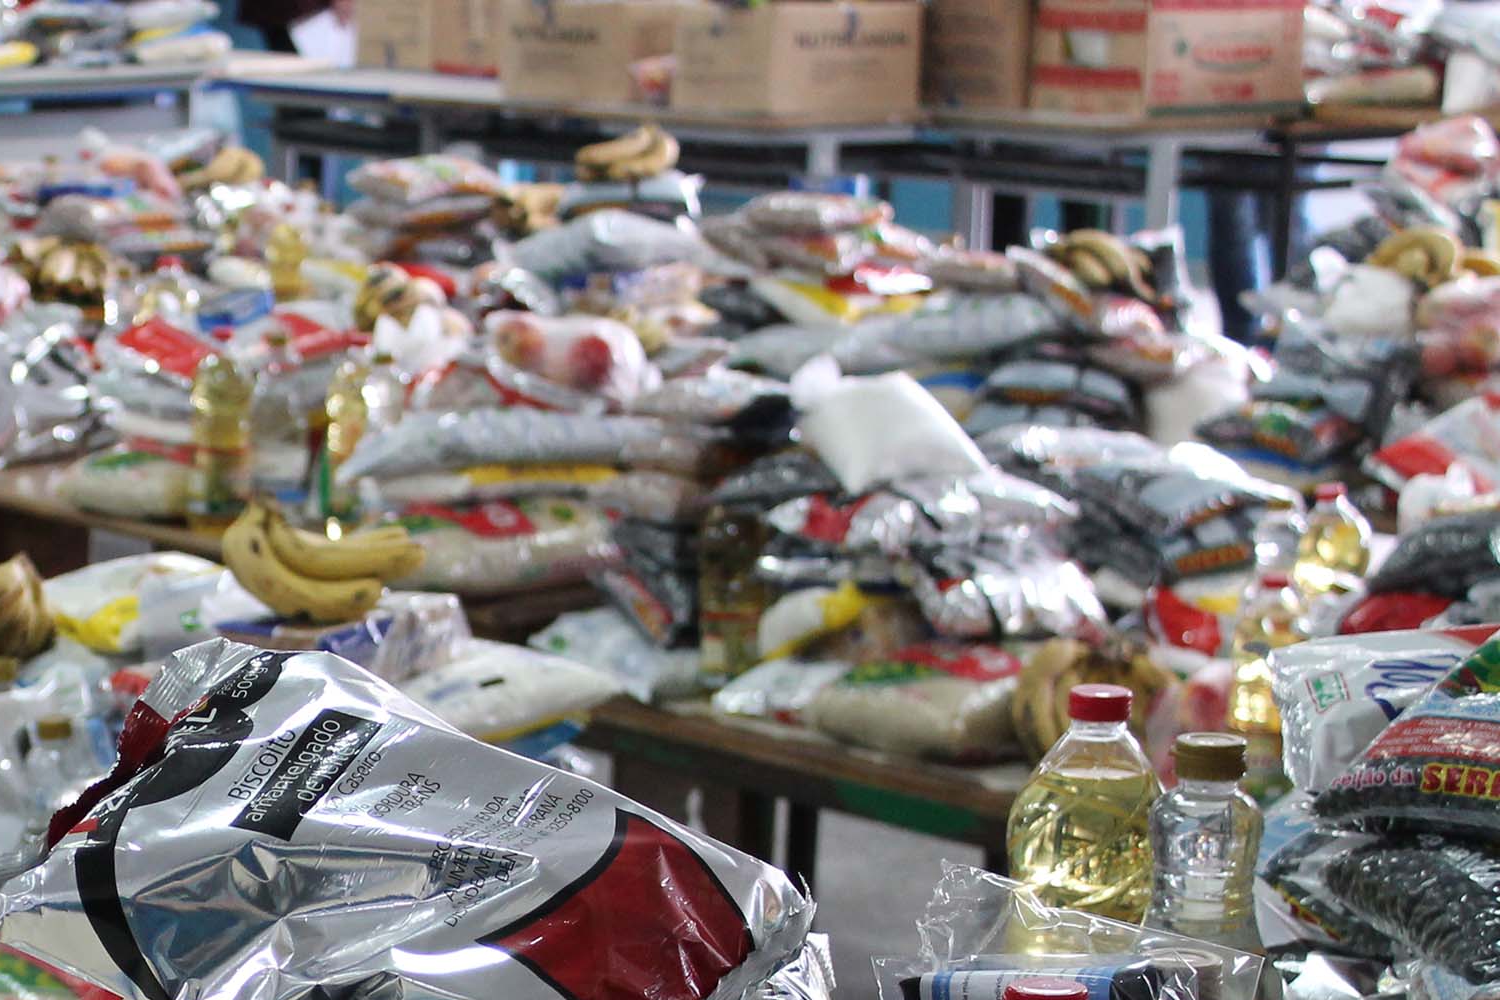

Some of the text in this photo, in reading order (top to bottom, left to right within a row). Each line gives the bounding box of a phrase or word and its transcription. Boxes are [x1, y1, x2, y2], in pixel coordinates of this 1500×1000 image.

[228, 729, 297, 800] Biscoito
[245, 718, 341, 823] amanteigado
[337, 751, 383, 797] Caseiro
[1389, 766, 1416, 786] da
